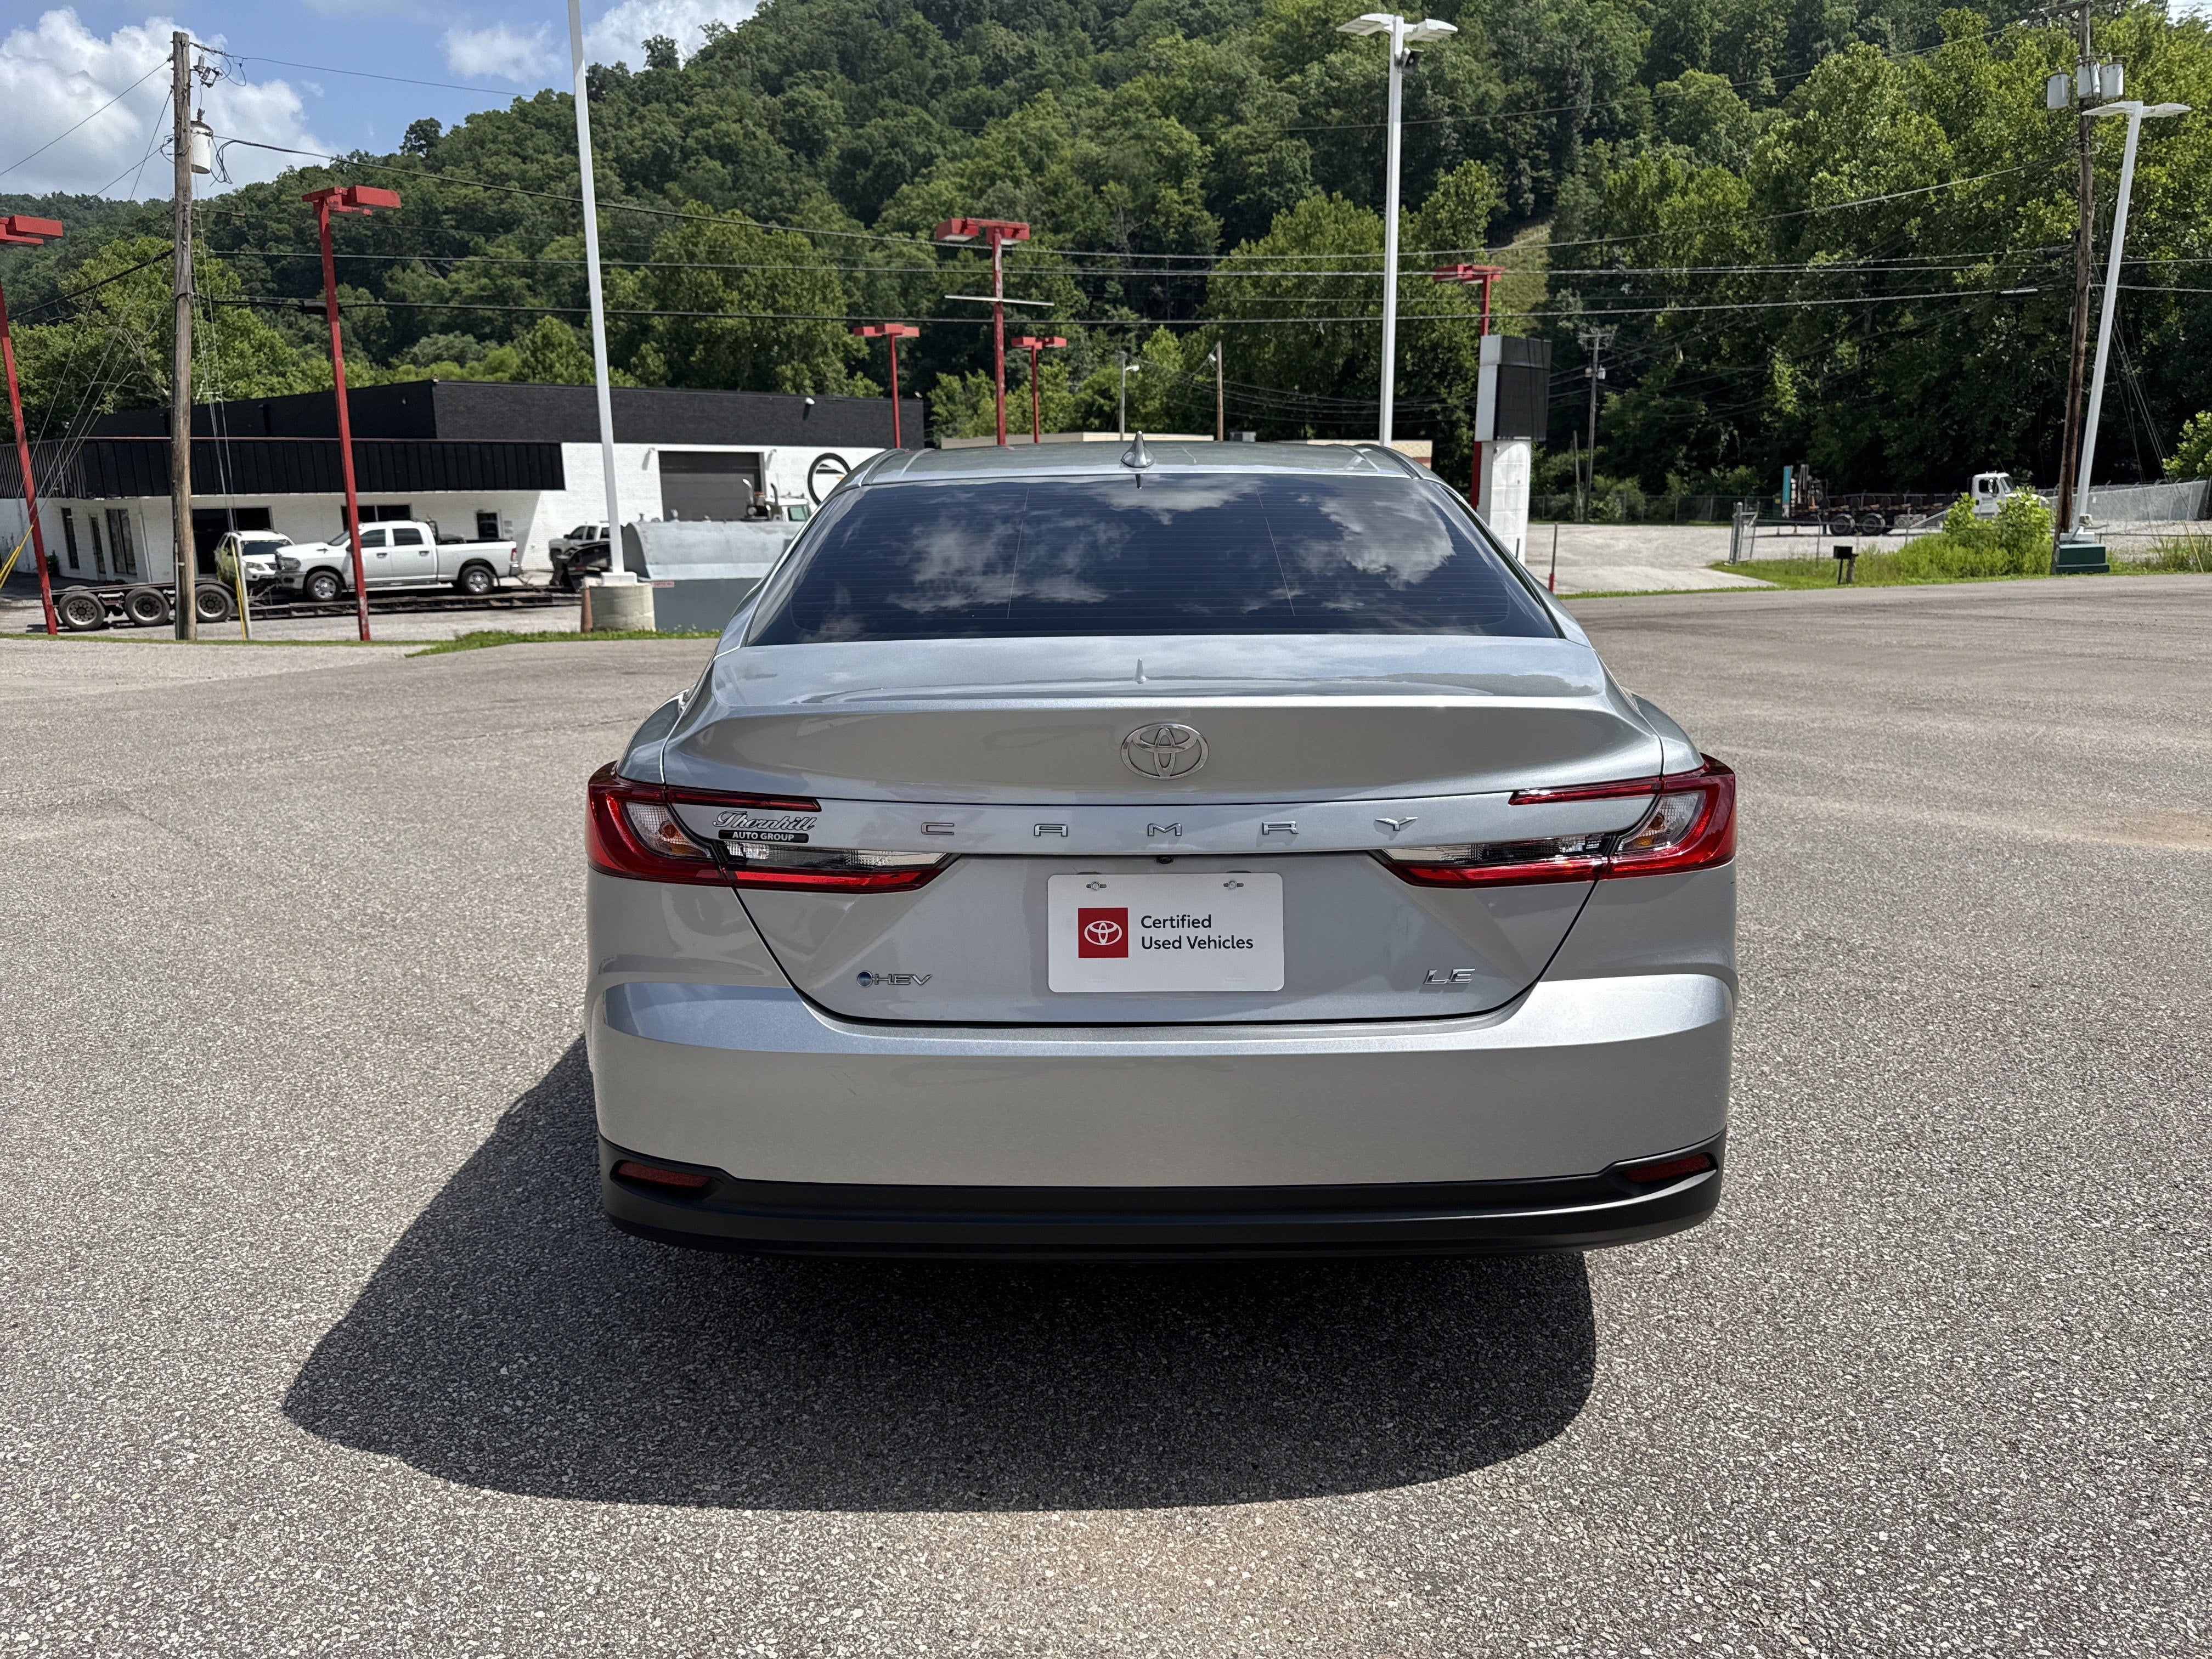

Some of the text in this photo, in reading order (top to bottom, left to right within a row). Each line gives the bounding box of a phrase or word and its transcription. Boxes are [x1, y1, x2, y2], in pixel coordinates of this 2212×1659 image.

[713, 810, 817, 831] Thornhill
[921, 816, 1418, 837] CAMRY
[732, 831, 795, 842] AUTO GROUP
[1141, 914, 1212, 929] Certified
[1141, 934, 1254, 950] Used Vehicles
[874, 973, 933, 985] HEV
[1424, 968, 1476, 984] LE
